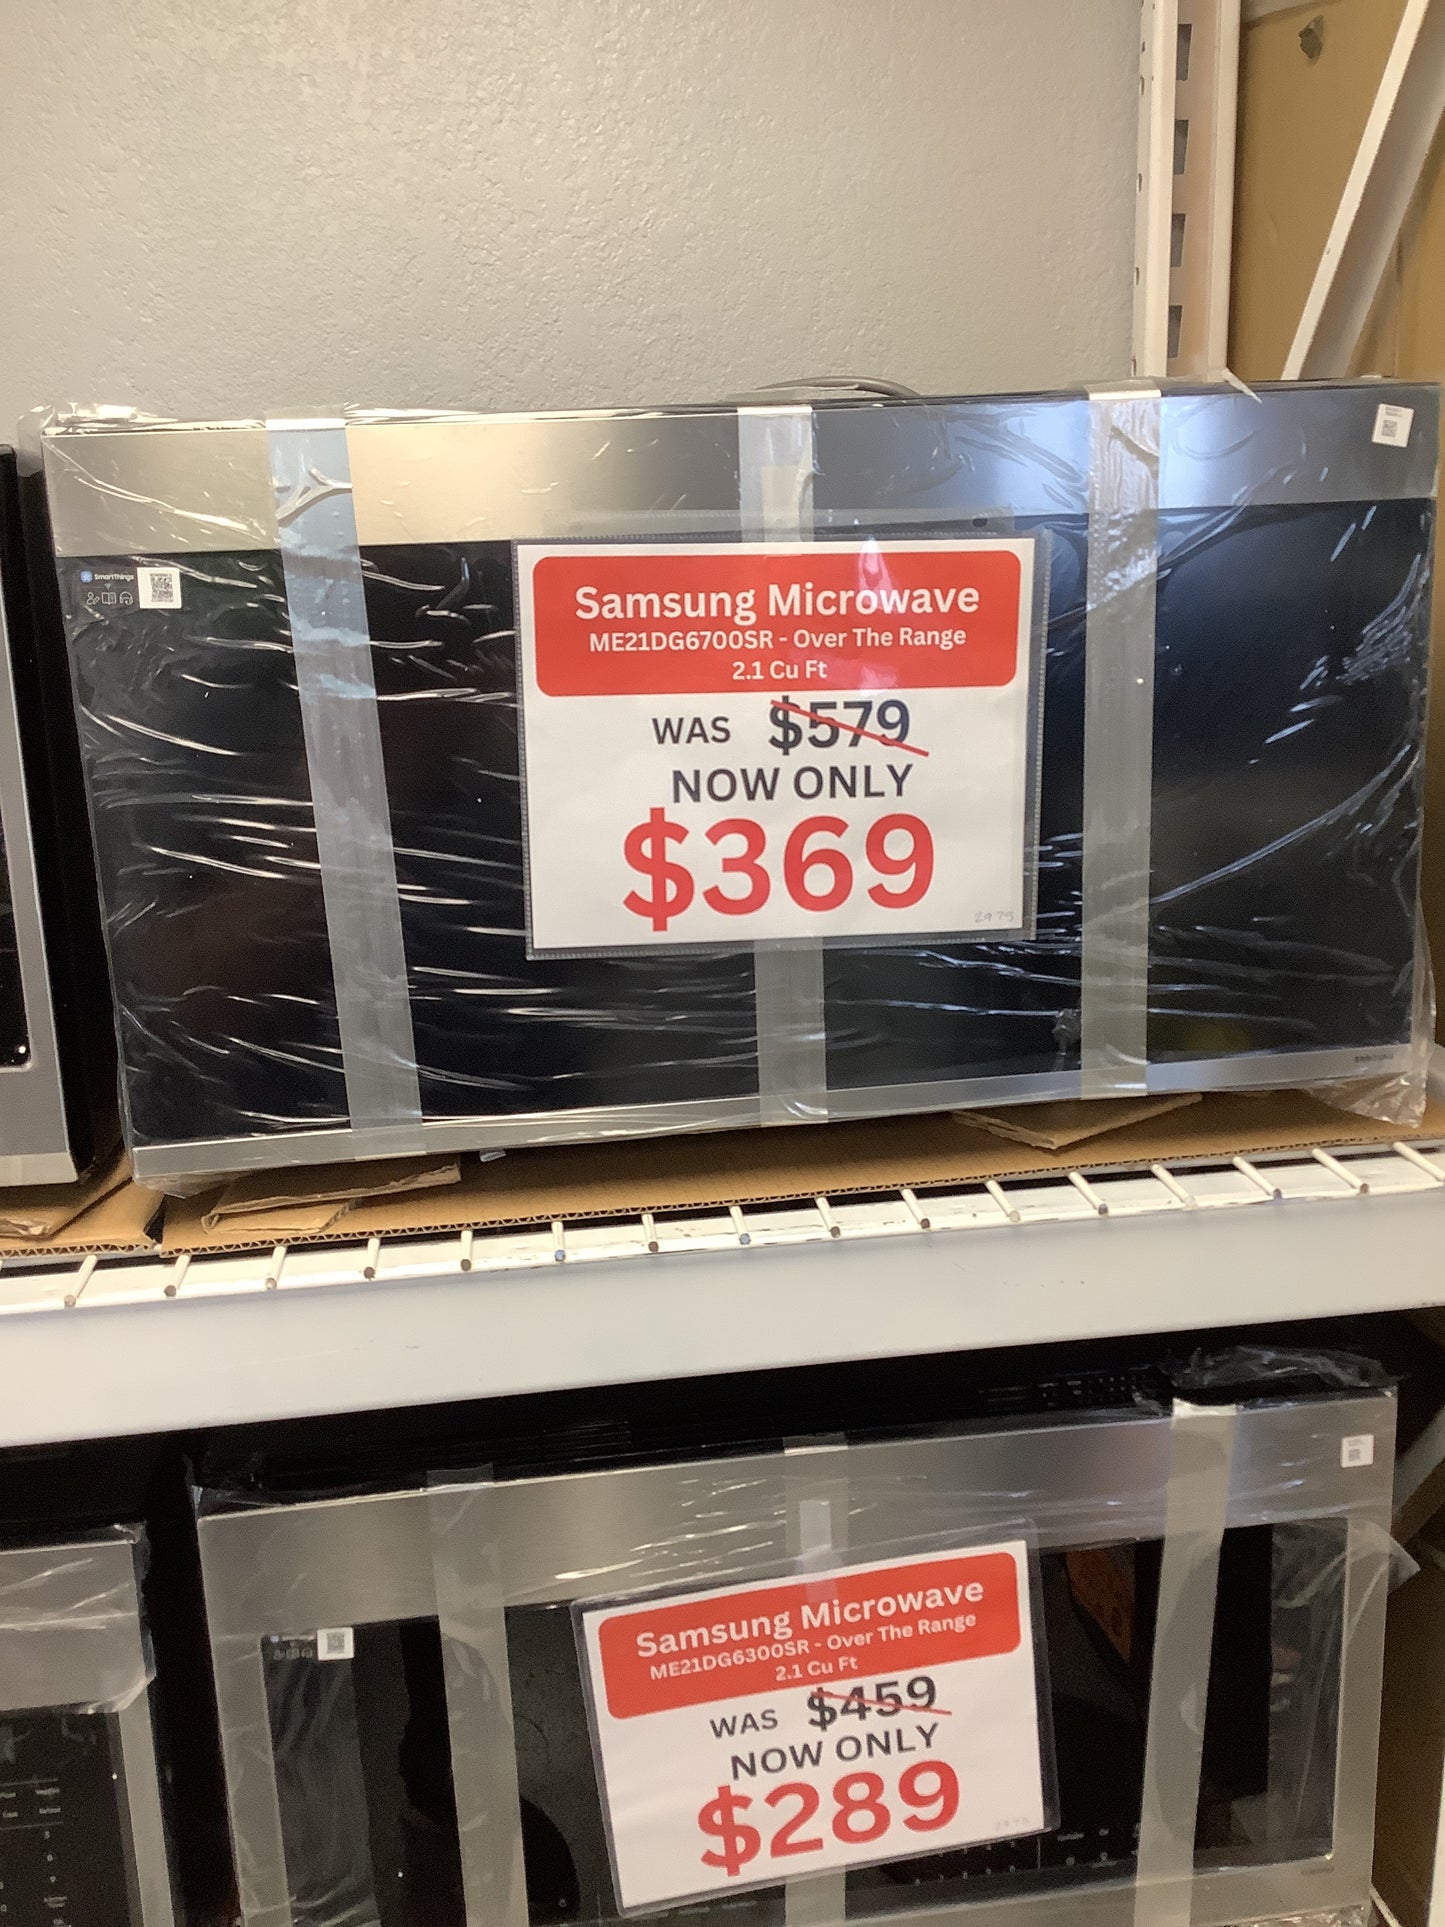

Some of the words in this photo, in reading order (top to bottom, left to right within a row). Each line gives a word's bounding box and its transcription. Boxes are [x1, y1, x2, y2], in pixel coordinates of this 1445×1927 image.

[94, 573, 134, 582] SmartThings
[575, 585, 756, 626] Samsung
[768, 583, 980, 617] Microwave
[589, 629, 773, 652] ME21DG6700SR
[793, 629, 847, 649] Over
[852, 628, 893, 648] The
[900, 627, 966, 651] Range
[732, 661, 764, 681] 2.1
[769, 660, 799, 680] Cu
[805, 660, 827, 679] Ft
[652, 716, 730, 746] WAS
[768, 696, 911, 756] $579
[673, 767, 780, 803] NOW
[793, 764, 913, 800] ONLY
[623, 807, 934, 932] $369
[635, 1610, 792, 1658] Samsung
[801, 1581, 984, 1630] Microwave
[649, 1639, 810, 1681] ME21DG6300SR
[827, 1630, 874, 1651] Over
[877, 1624, 914, 1642] The
[918, 1612, 977, 1636] Range
[775, 1663, 804, 1683] 2.1
[807, 1659, 834, 1677] Cu
[838, 1656, 859, 1672] Ft
[710, 1709, 779, 1739] WAS
[807, 1675, 937, 1731] $459
[731, 1741, 824, 1780] NOW
[835, 1722, 940, 1762] ONLY
[698, 1759, 960, 1877] $289
